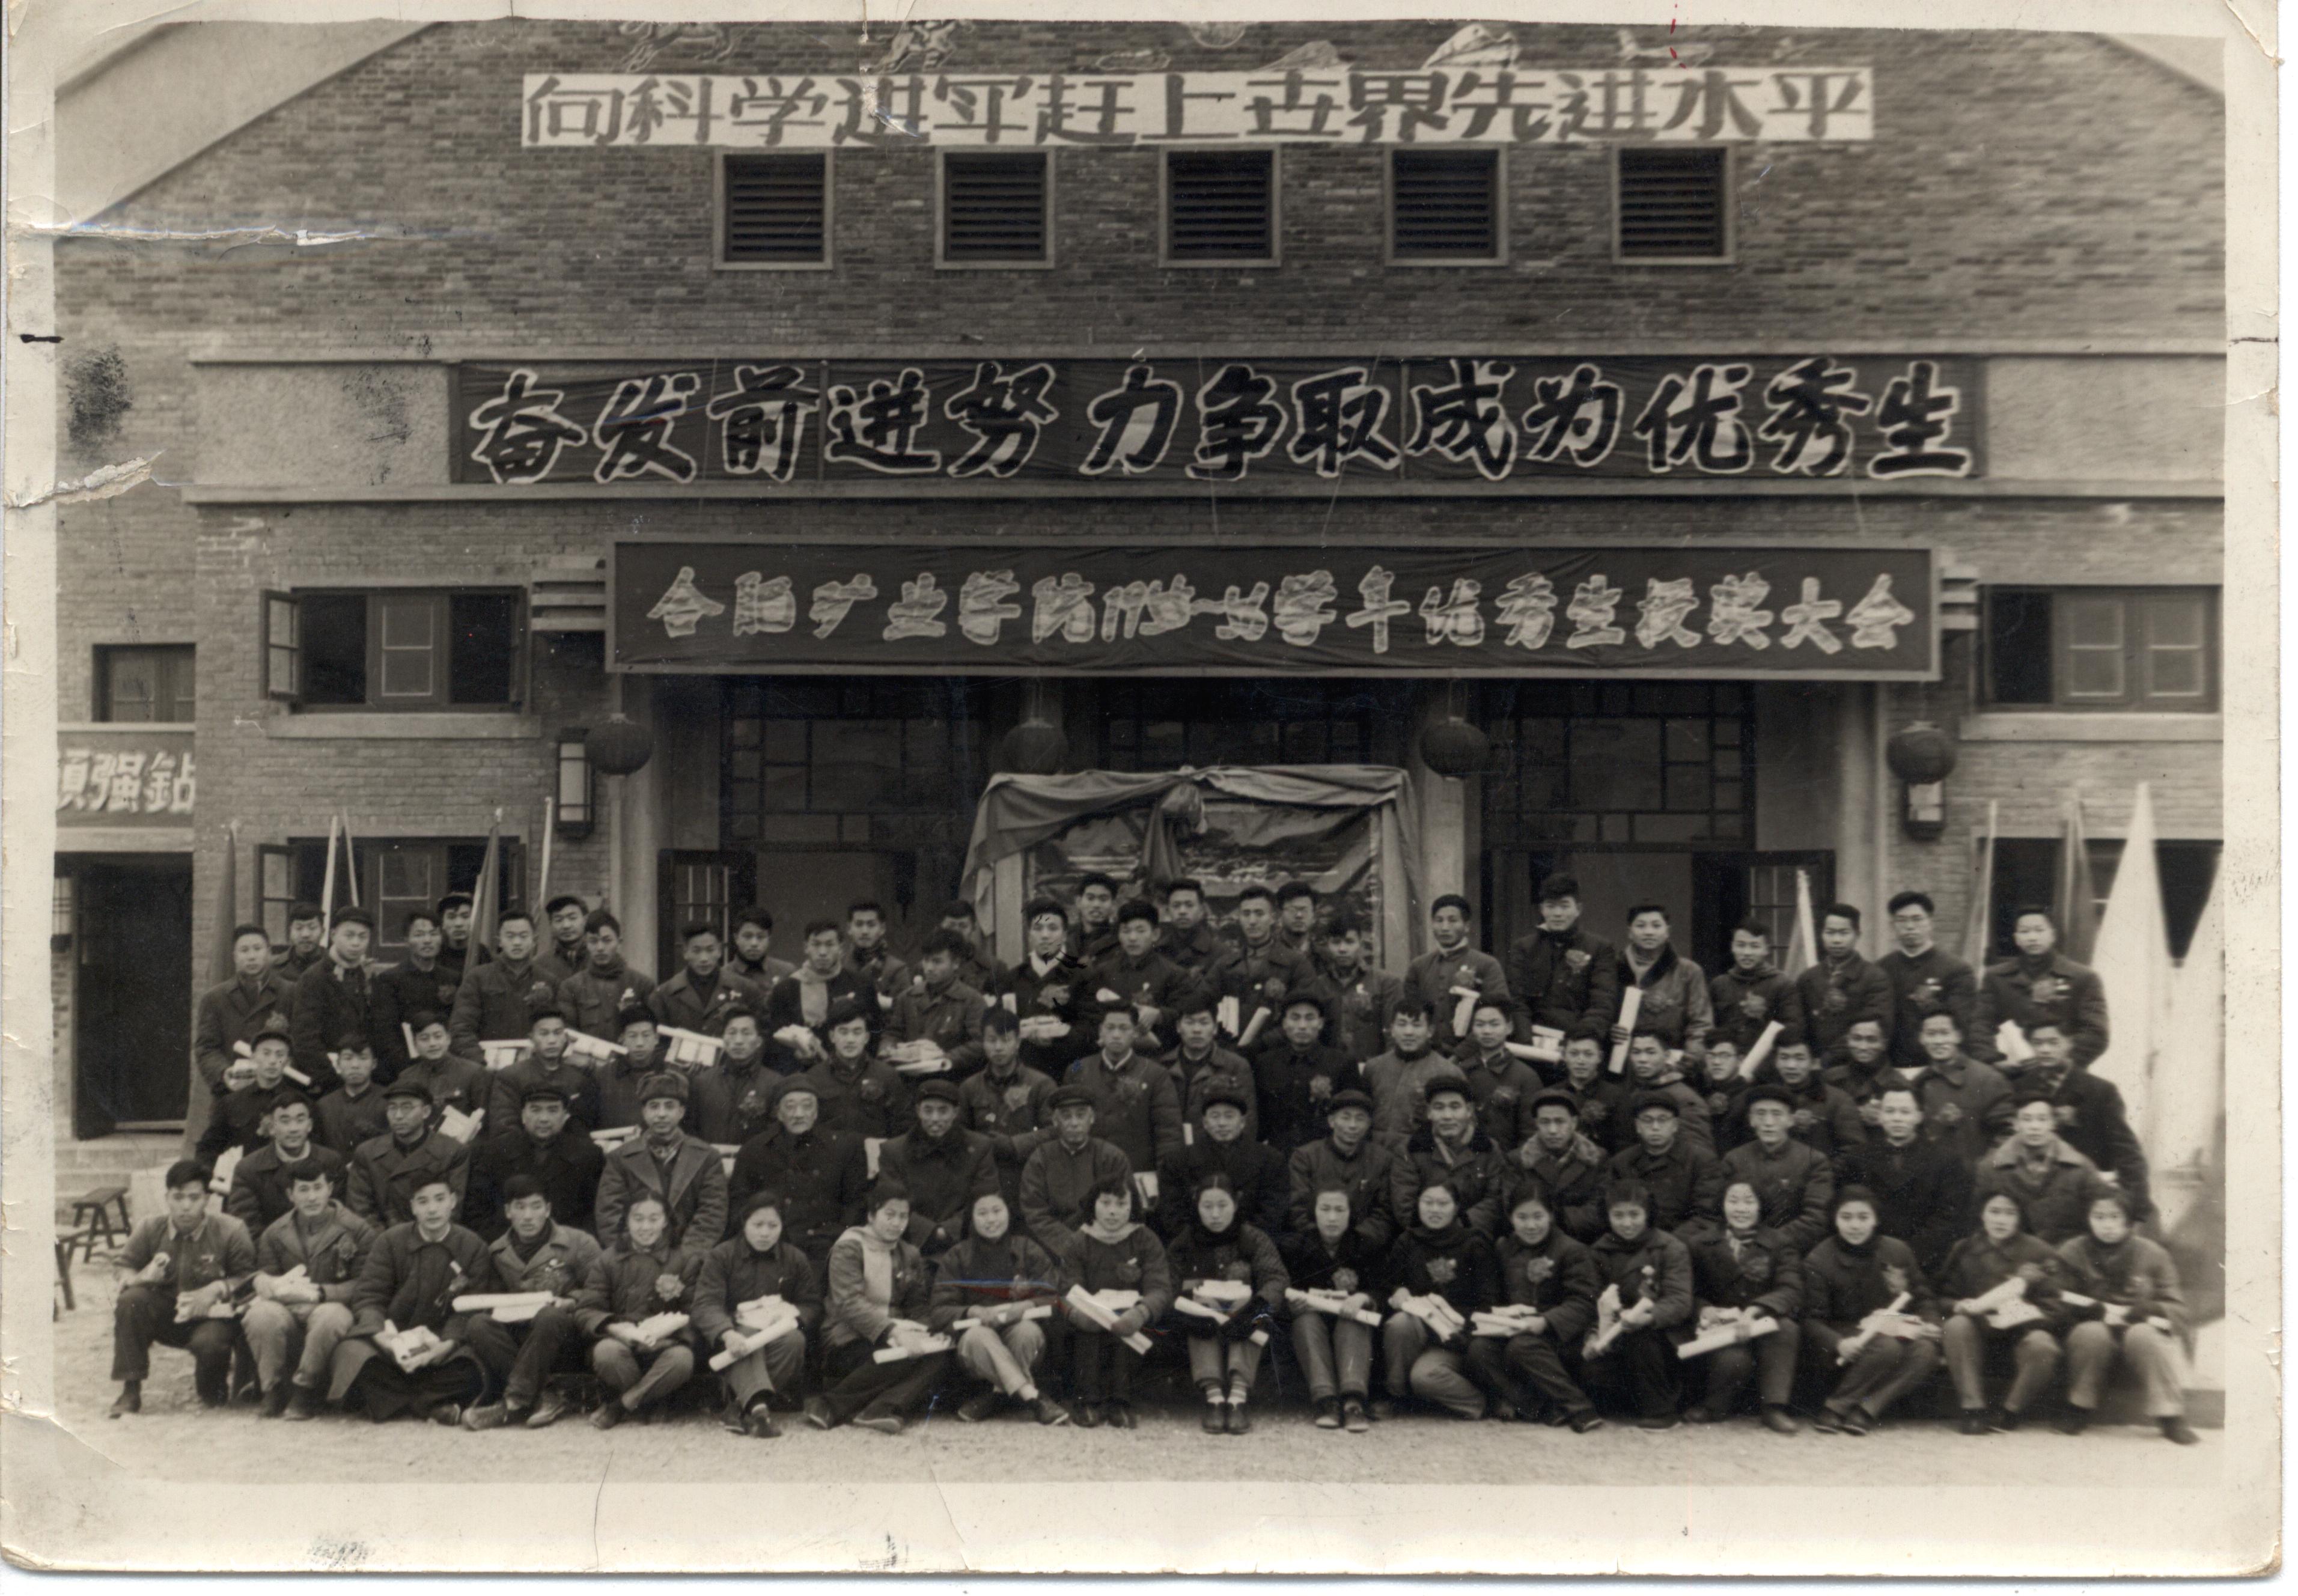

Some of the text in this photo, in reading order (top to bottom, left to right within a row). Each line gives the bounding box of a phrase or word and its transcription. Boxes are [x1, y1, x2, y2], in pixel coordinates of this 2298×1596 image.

[470, 358, 1973, 483] 奋发前进努力争取成为优秀生
